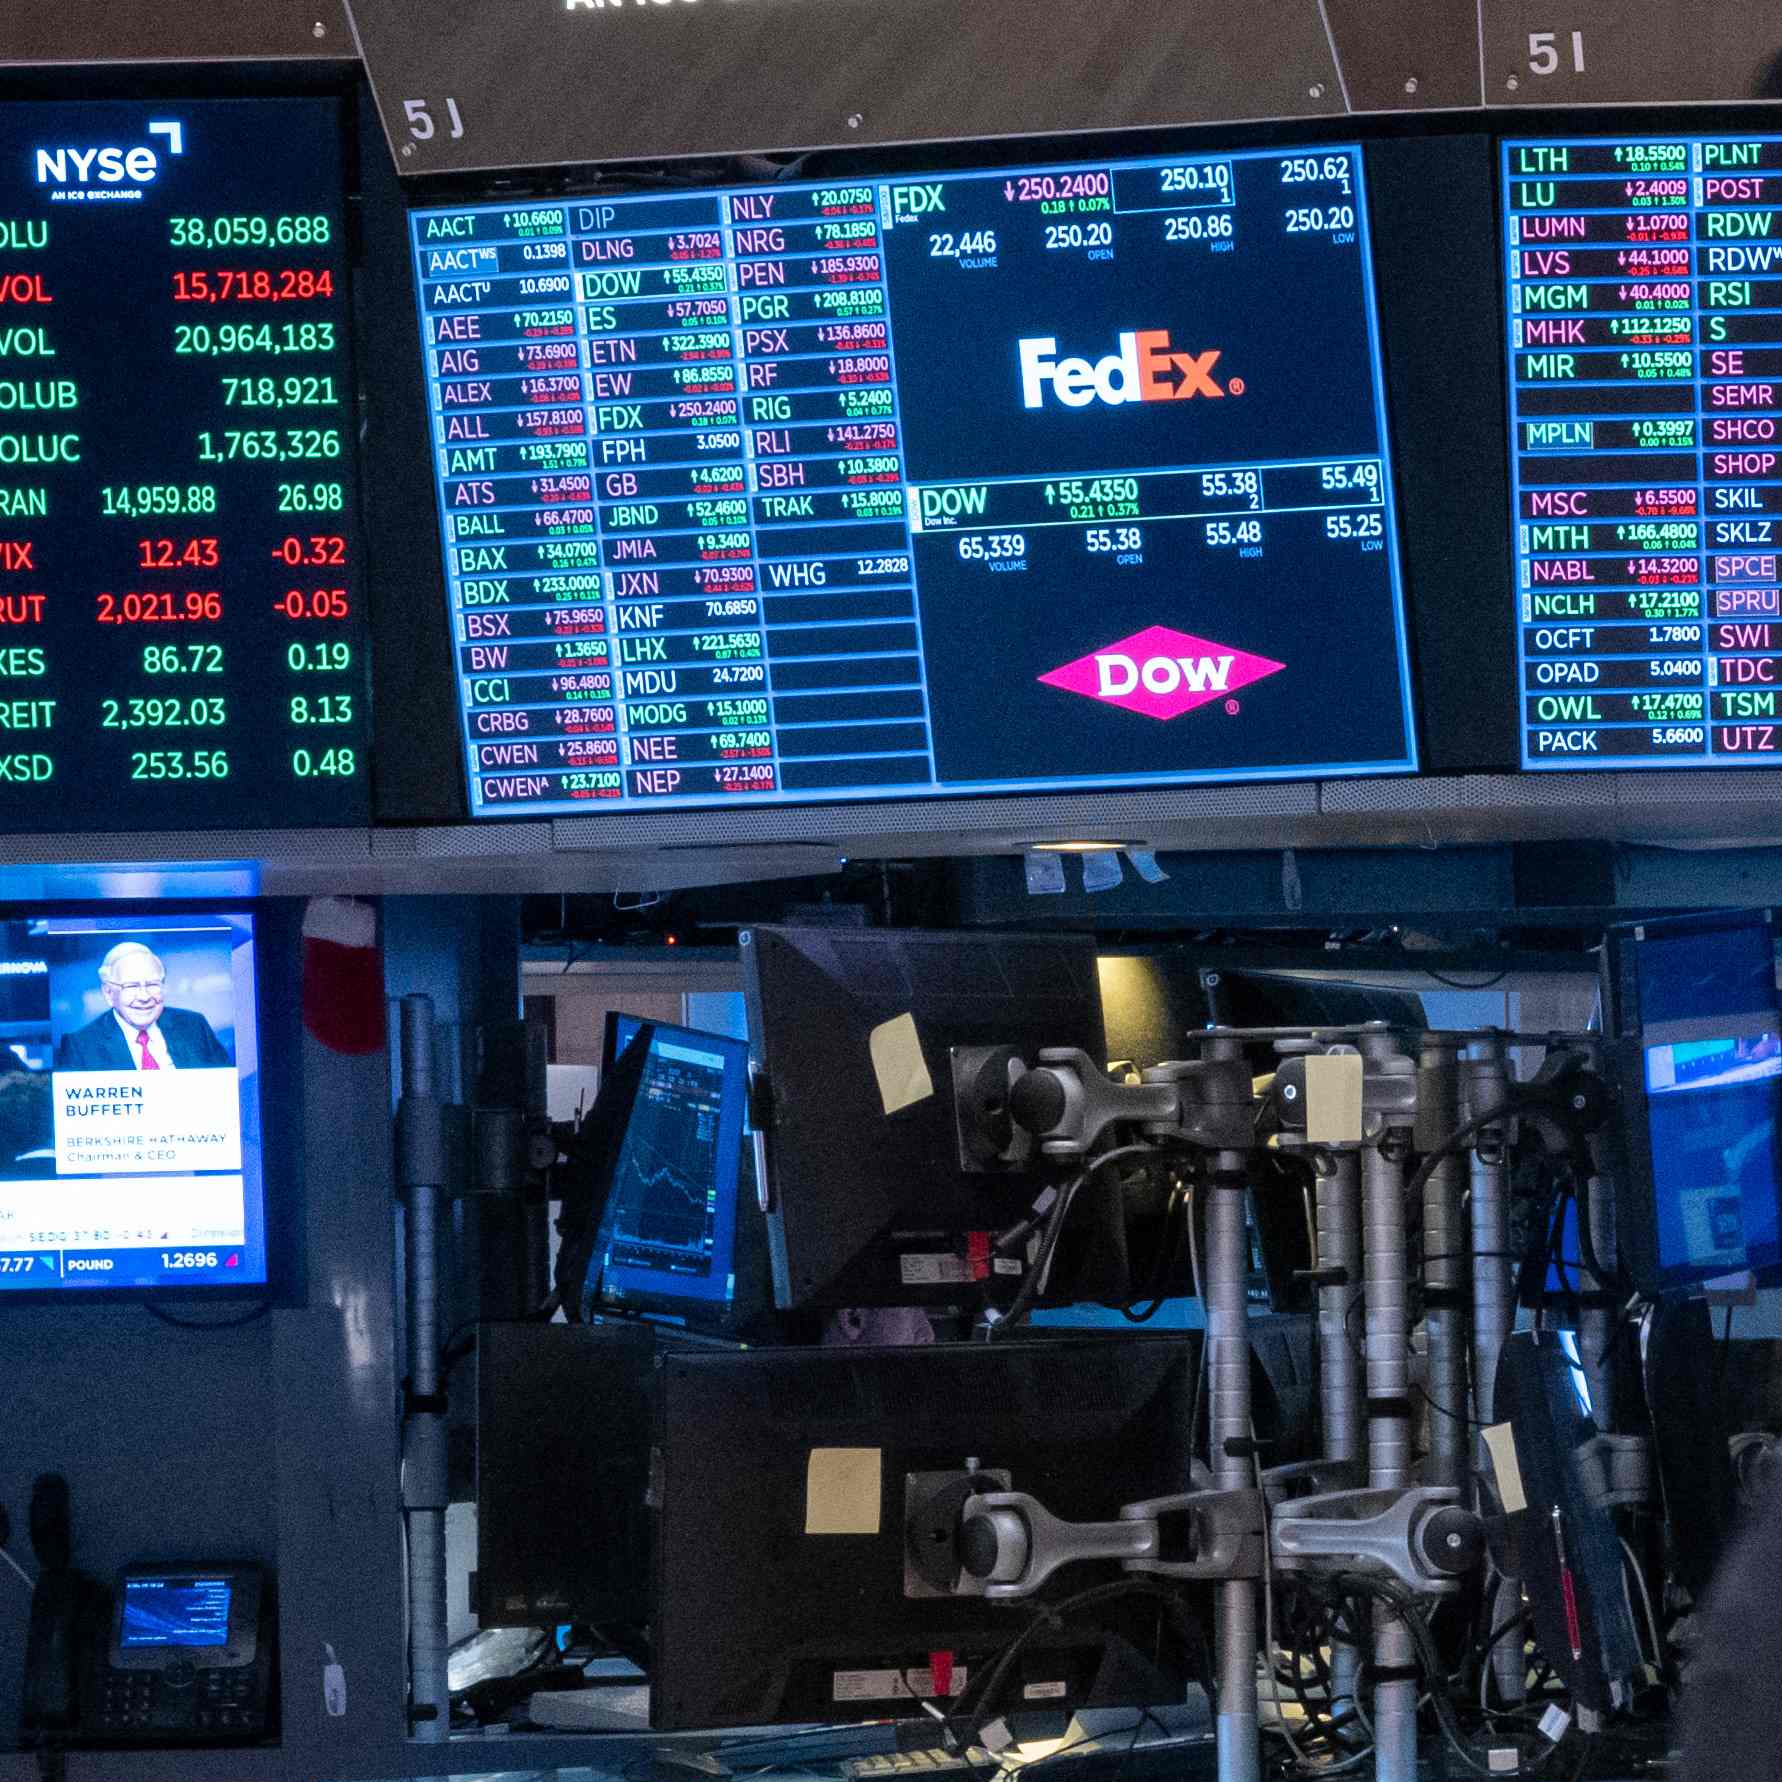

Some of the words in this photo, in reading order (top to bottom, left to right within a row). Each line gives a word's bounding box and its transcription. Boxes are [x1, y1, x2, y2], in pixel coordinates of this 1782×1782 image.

[1519, 149, 1568, 172] LTH
[1704, 144, 1761, 165] PLNT
[894, 185, 945, 213] FDX
[1018, 174, 1108, 201] 250.2400
[1160, 166, 1228, 191] 250.10
[1280, 157, 1349, 182] 250.62
[169, 217, 330, 249] 38,059,688
[427, 216, 476, 237] AACT
[579, 207, 616, 230] DIP
[929, 230, 996, 258] 22,446
[1045, 223, 1112, 249] 250.20
[1164, 216, 1232, 240] 250.86
[1286, 207, 1354, 231] 250.20
[582, 239, 634, 262] DLNG
[736, 229, 786, 254] NRG
[959, 257, 998, 269] VOLUME
[1087, 249, 1114, 260] OPEN
[1210, 241, 1233, 252] HIGH
[1332, 233, 1354, 244] LOW
[173, 270, 333, 303] 15,718,284
[586, 272, 641, 297] DOW
[1524, 286, 1588, 309] MGM
[175, 323, 335, 356] 20,964,183
[592, 339, 637, 364] ETN
[1018, 330, 1224, 408] FedEx
[222, 378, 338, 408] 718,921
[198, 432, 340, 462] 1,763,326
[102, 487, 215, 517] 14,959.88
[278, 485, 342, 512] 26.98
[922, 488, 986, 517] DOW
[1059, 480, 1138, 504] 55.4350
[1201, 472, 1256, 496] 55.38
[1322, 464, 1377, 489] 55.49
[1716, 521, 1771, 542] SKLZ
[139, 539, 219, 568] 12.43
[272, 538, 346, 565] -0.32
[464, 579, 508, 605] BDX
[541, 575, 601, 594] 233.0000
[769, 562, 826, 589] WHG
[97, 594, 221, 623] 2,021.96
[274, 591, 347, 619] -0.05
[144, 646, 223, 674] 86.72
[102, 699, 226, 729] 2,392.03
[291, 697, 352, 723] 8.13
[132, 752, 228, 779] 253.56
[66, 1087, 143, 1099] WARREN
[66, 1104, 144, 1117] BUFFETT
[67, 1136, 144, 1147] BERKSHIRE
[149, 1134, 227, 1145] HATHAWAY
[148, 1151, 175, 1160] CEO
[68, 1259, 113, 1271] POUND
[161, 1254, 217, 1268] 1.2696
